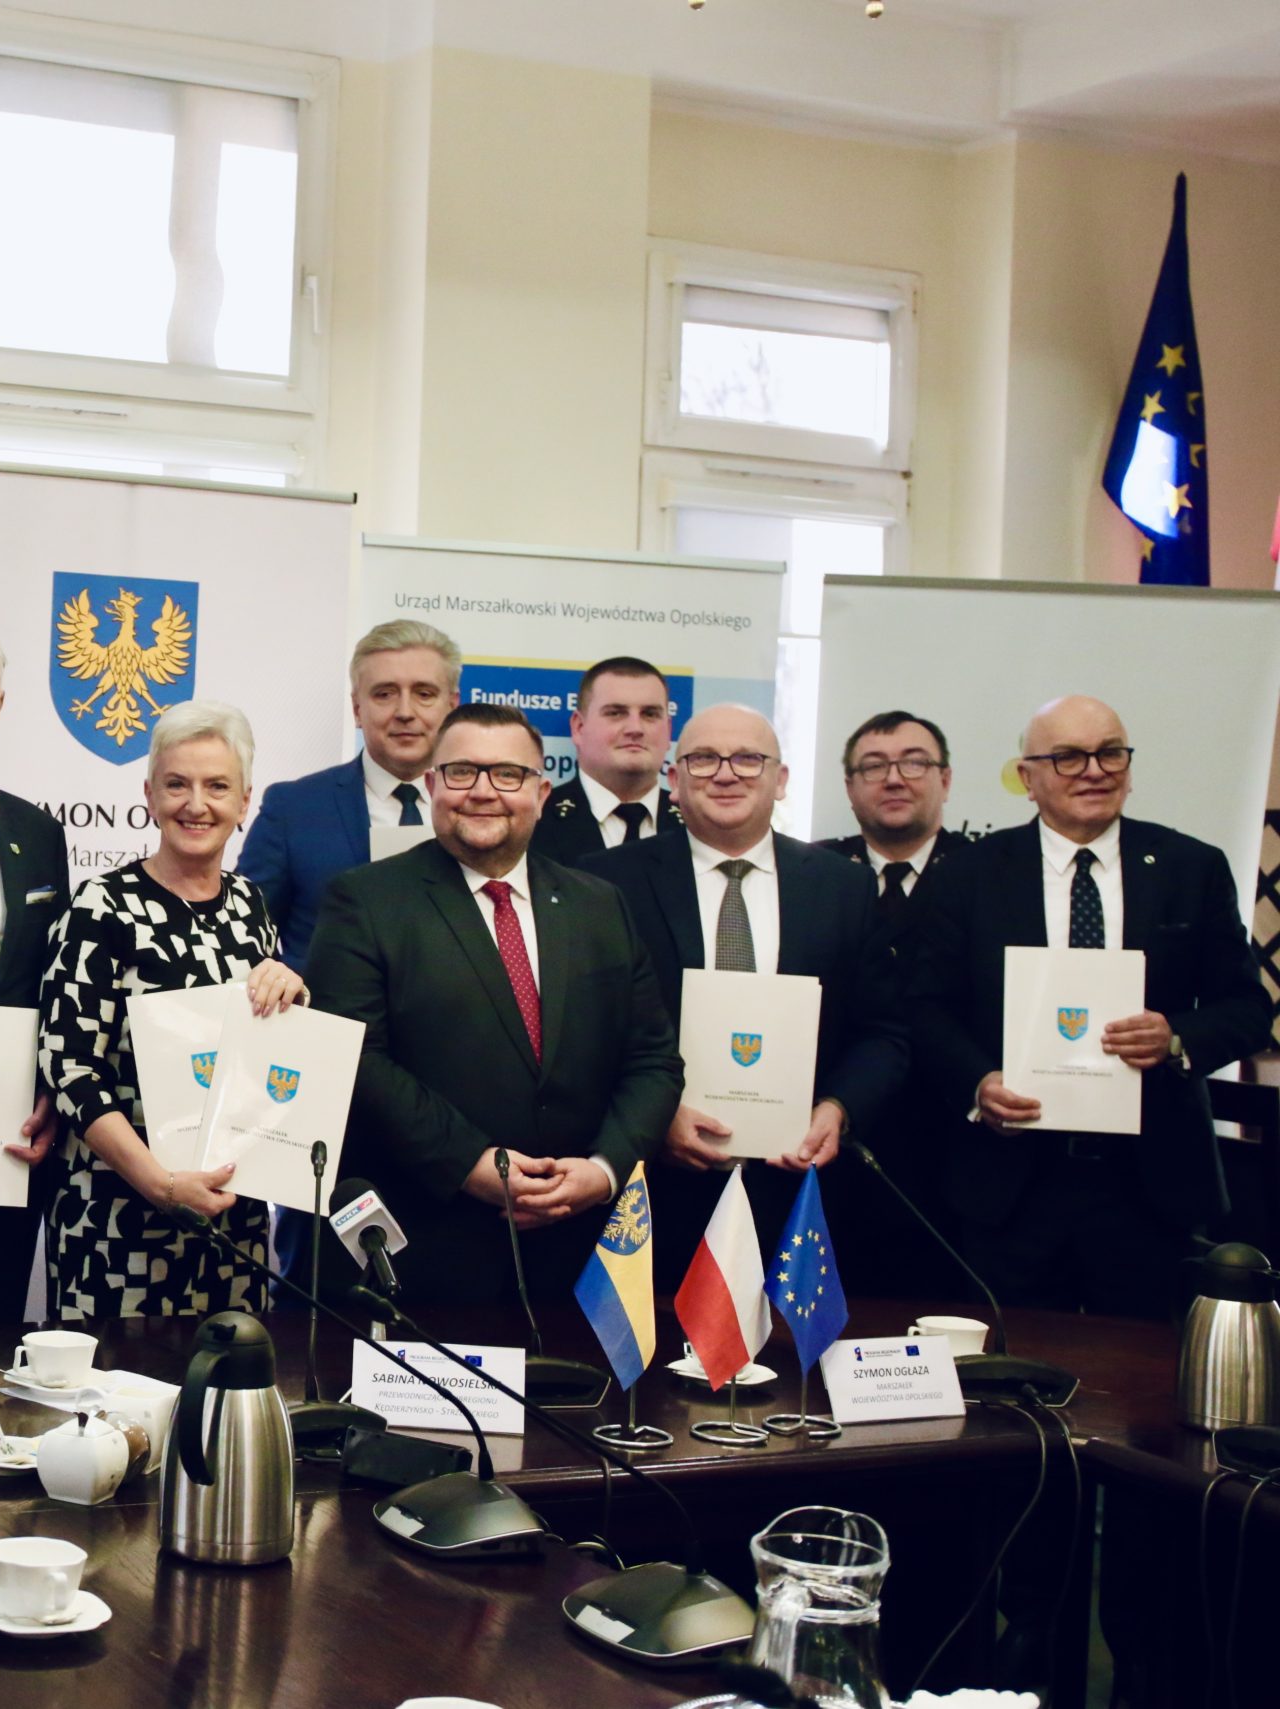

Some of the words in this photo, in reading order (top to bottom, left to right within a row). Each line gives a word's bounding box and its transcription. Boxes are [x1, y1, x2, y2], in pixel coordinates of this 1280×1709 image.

[395, 593, 441, 612] Urząd
[446, 596, 557, 617] Marszałkowski
[561, 602, 666, 623] Województwa
[670, 609, 752, 632] Opolskiego
[471, 688, 561, 711] Fundusze
[372, 1372, 415, 1385] SABINA
[853, 1367, 892, 1379] SZYMON
[894, 1365, 930, 1377] OGŁAZA
